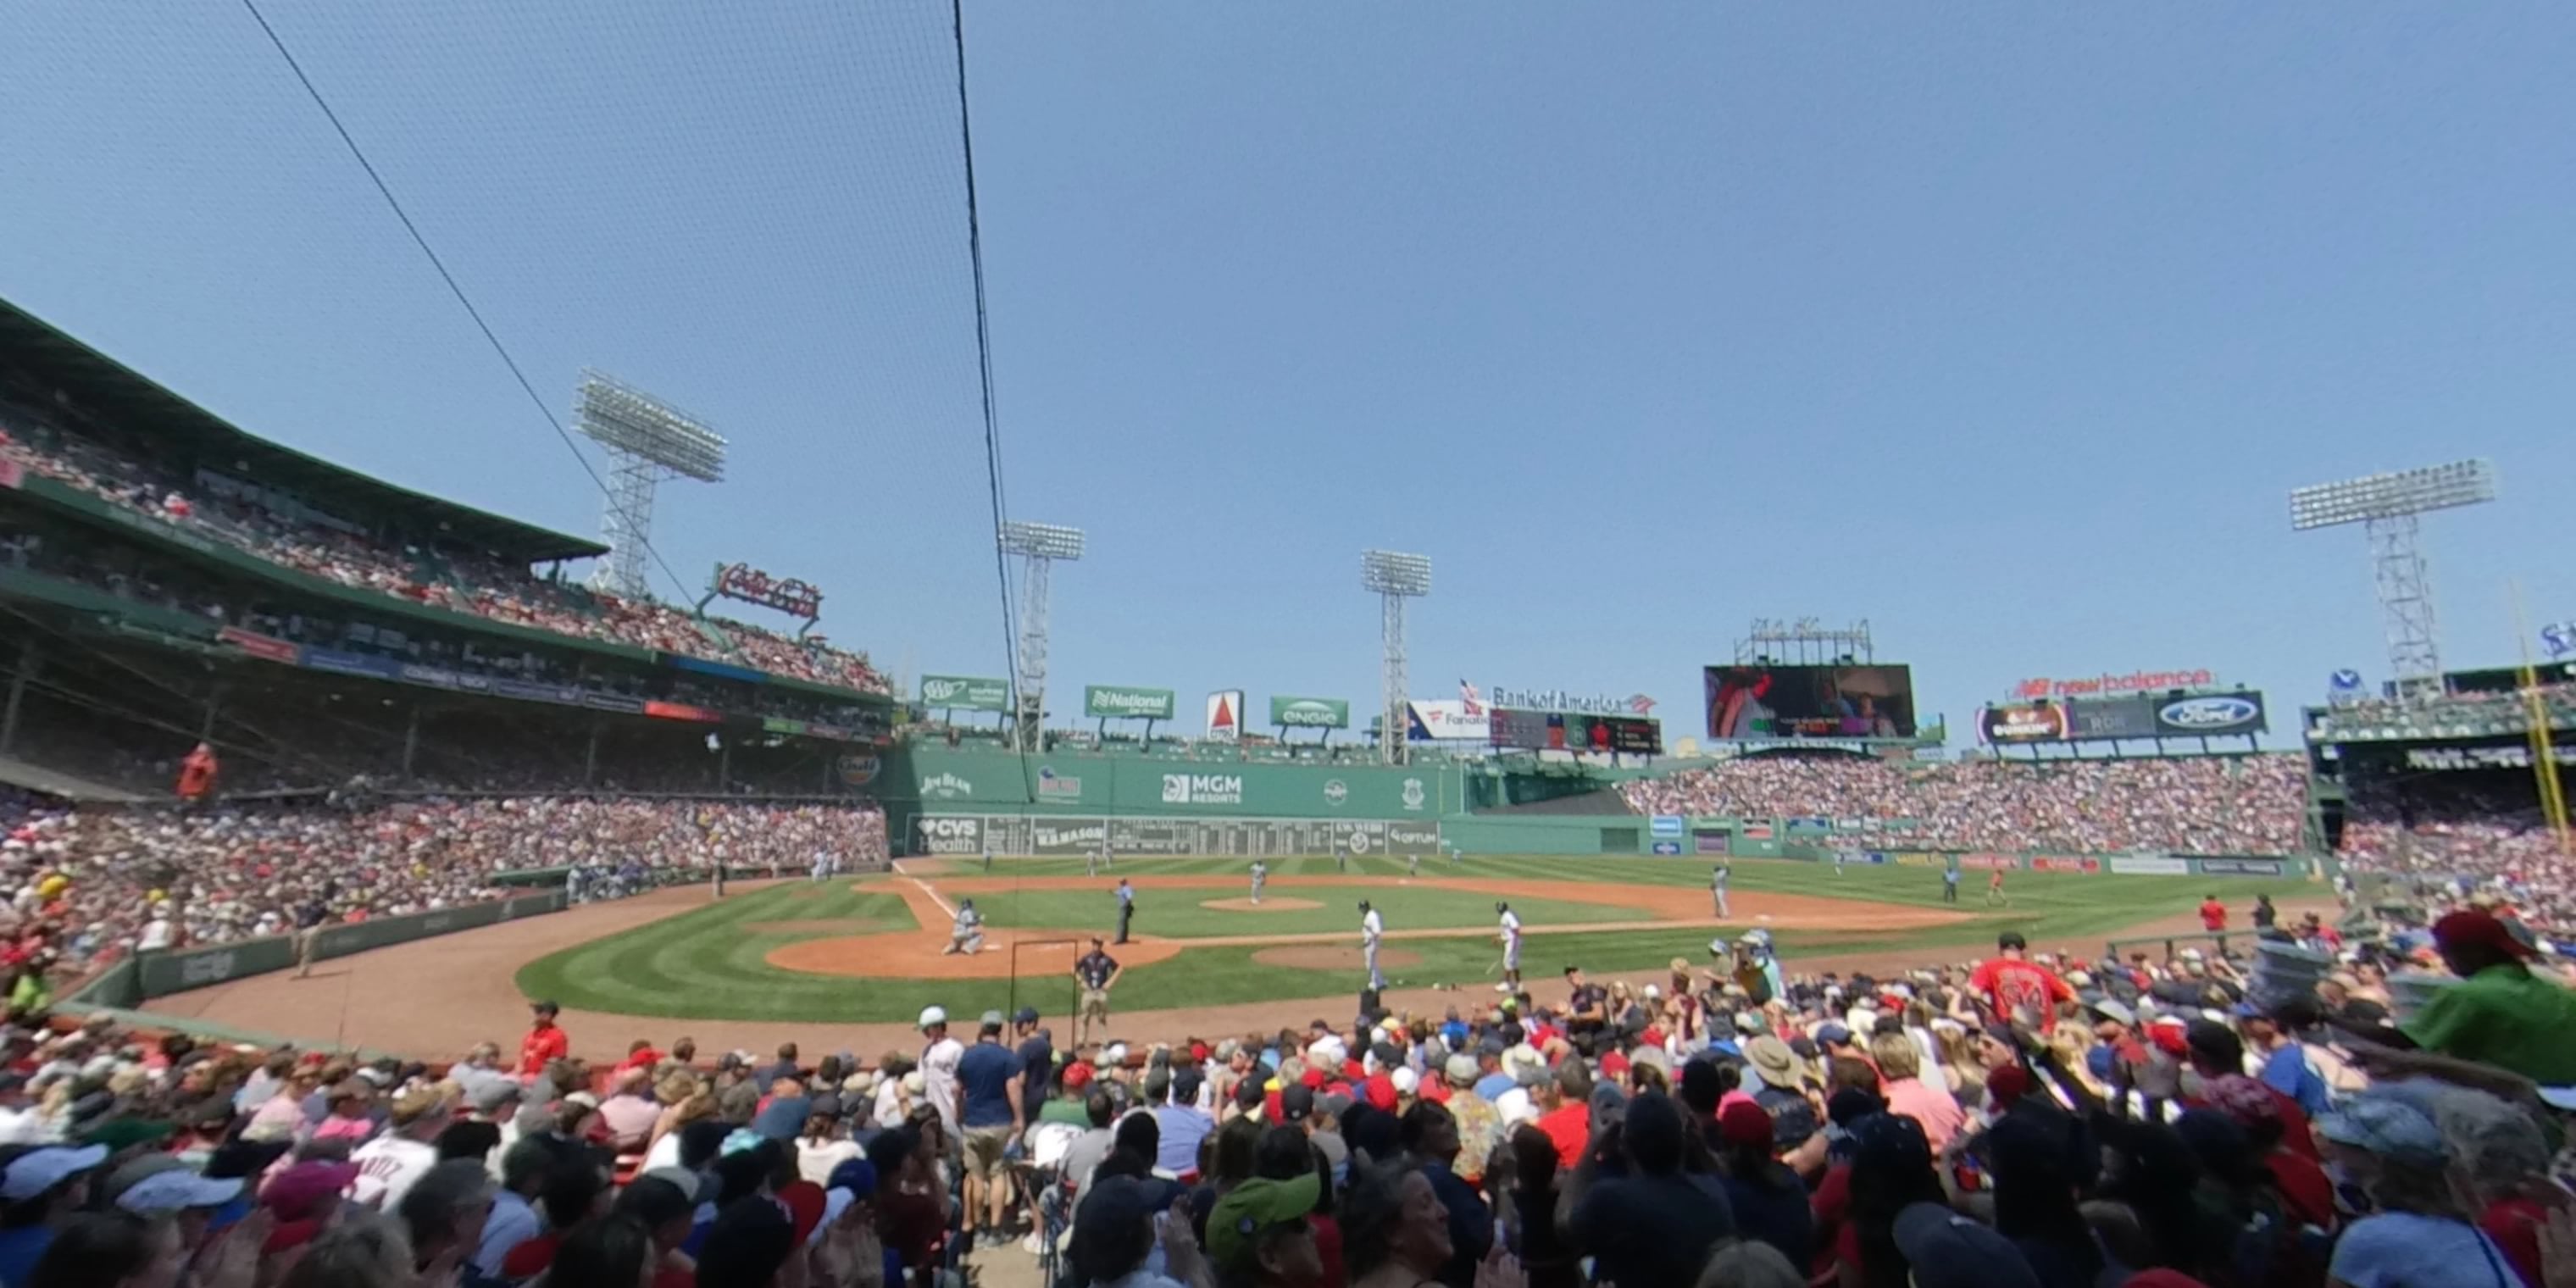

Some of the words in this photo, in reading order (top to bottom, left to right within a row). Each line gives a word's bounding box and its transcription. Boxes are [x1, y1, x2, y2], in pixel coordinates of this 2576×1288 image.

[2054, 680, 2101, 696] new
[2102, 669, 2211, 691] balance
[1109, 691, 1167, 708] National
[1493, 686, 1536, 708] Bank
[1538, 690, 1555, 708] of
[1557, 691, 1622, 712] America
[2179, 705, 2235, 723] Ford
[941, 772, 971, 794] BEAM
[1192, 775, 1241, 792] MGM
[1192, 793, 1241, 803] RESORTS
[937, 819, 976, 836] CVS
[919, 836, 974, 852] Health
[1401, 833, 1436, 844] OPTUM
